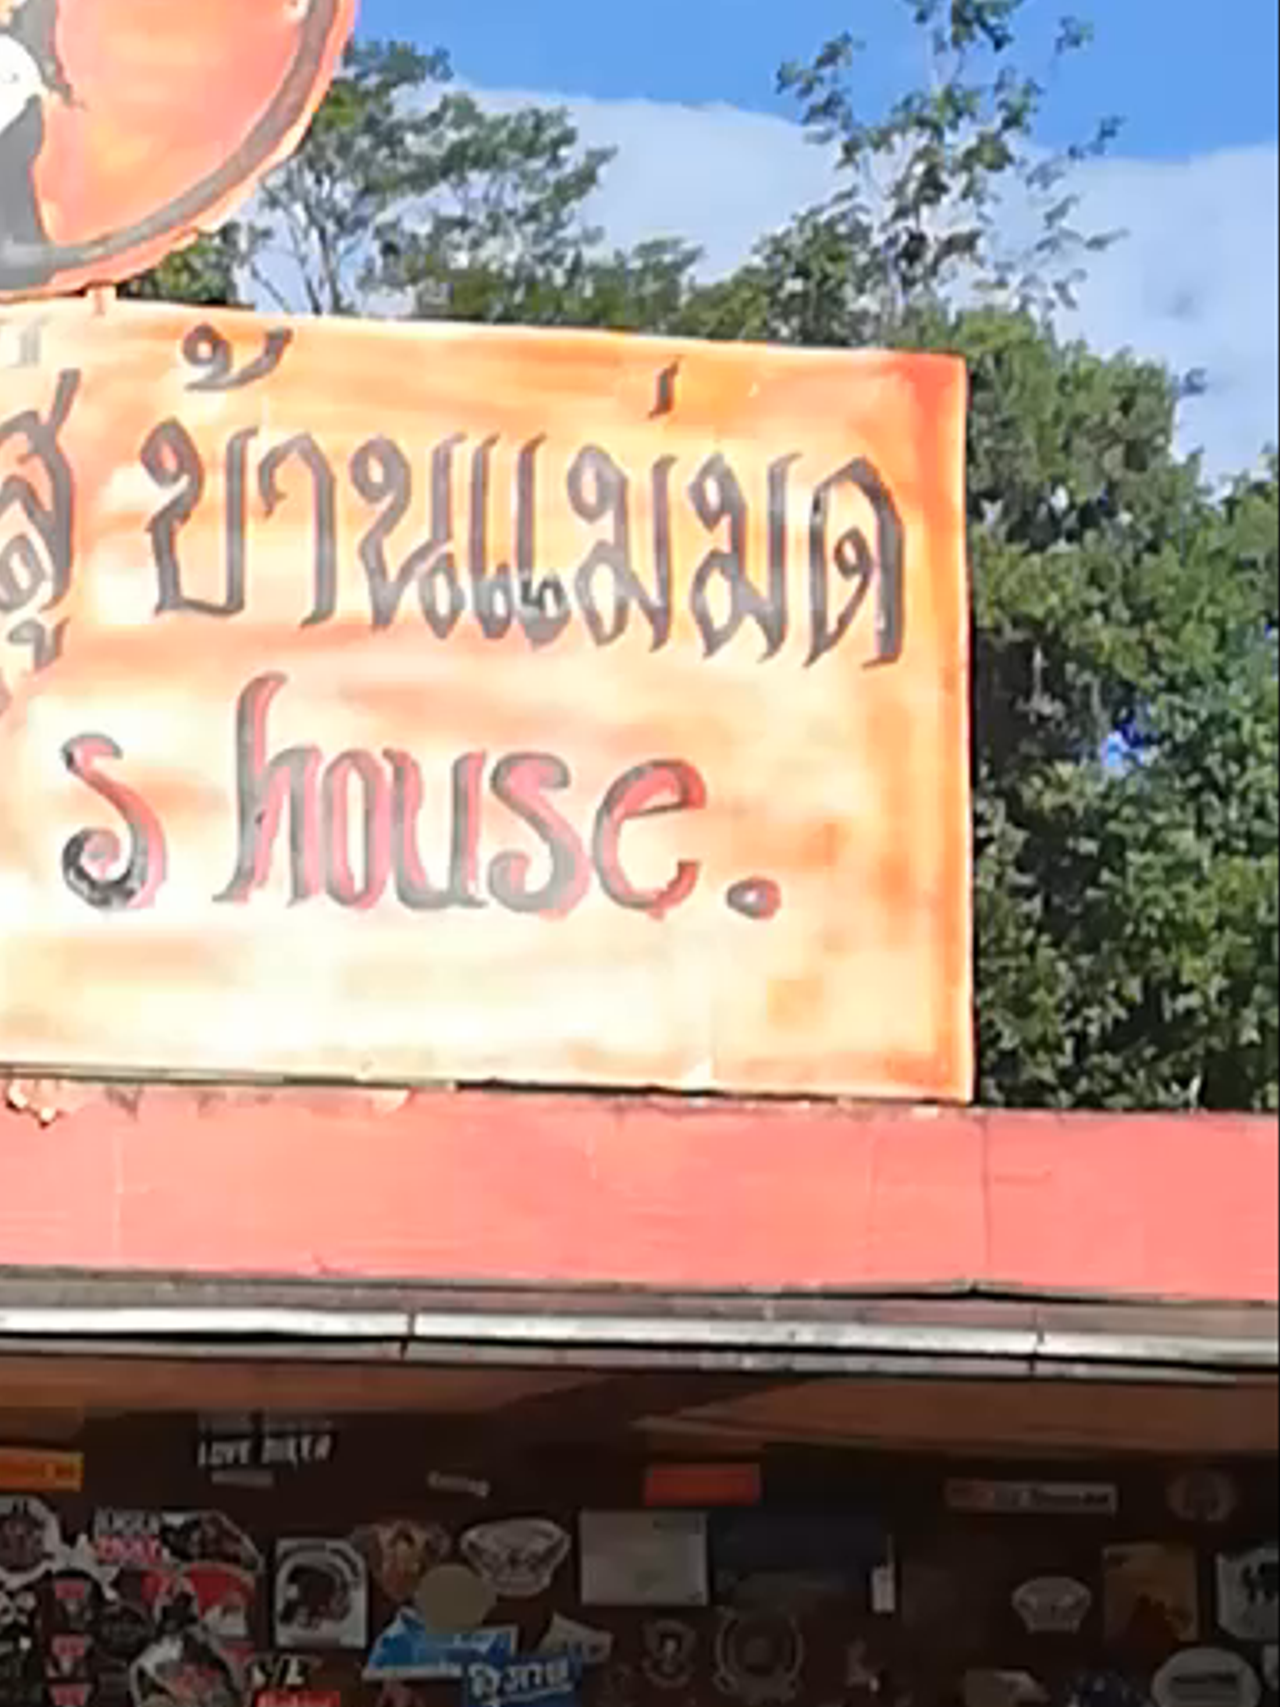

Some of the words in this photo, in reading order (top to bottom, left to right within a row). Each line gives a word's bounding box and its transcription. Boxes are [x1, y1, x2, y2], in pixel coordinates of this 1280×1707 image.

[138, 321, 906, 670] บ้านแม่มด
[211, 670, 784, 921] house.
